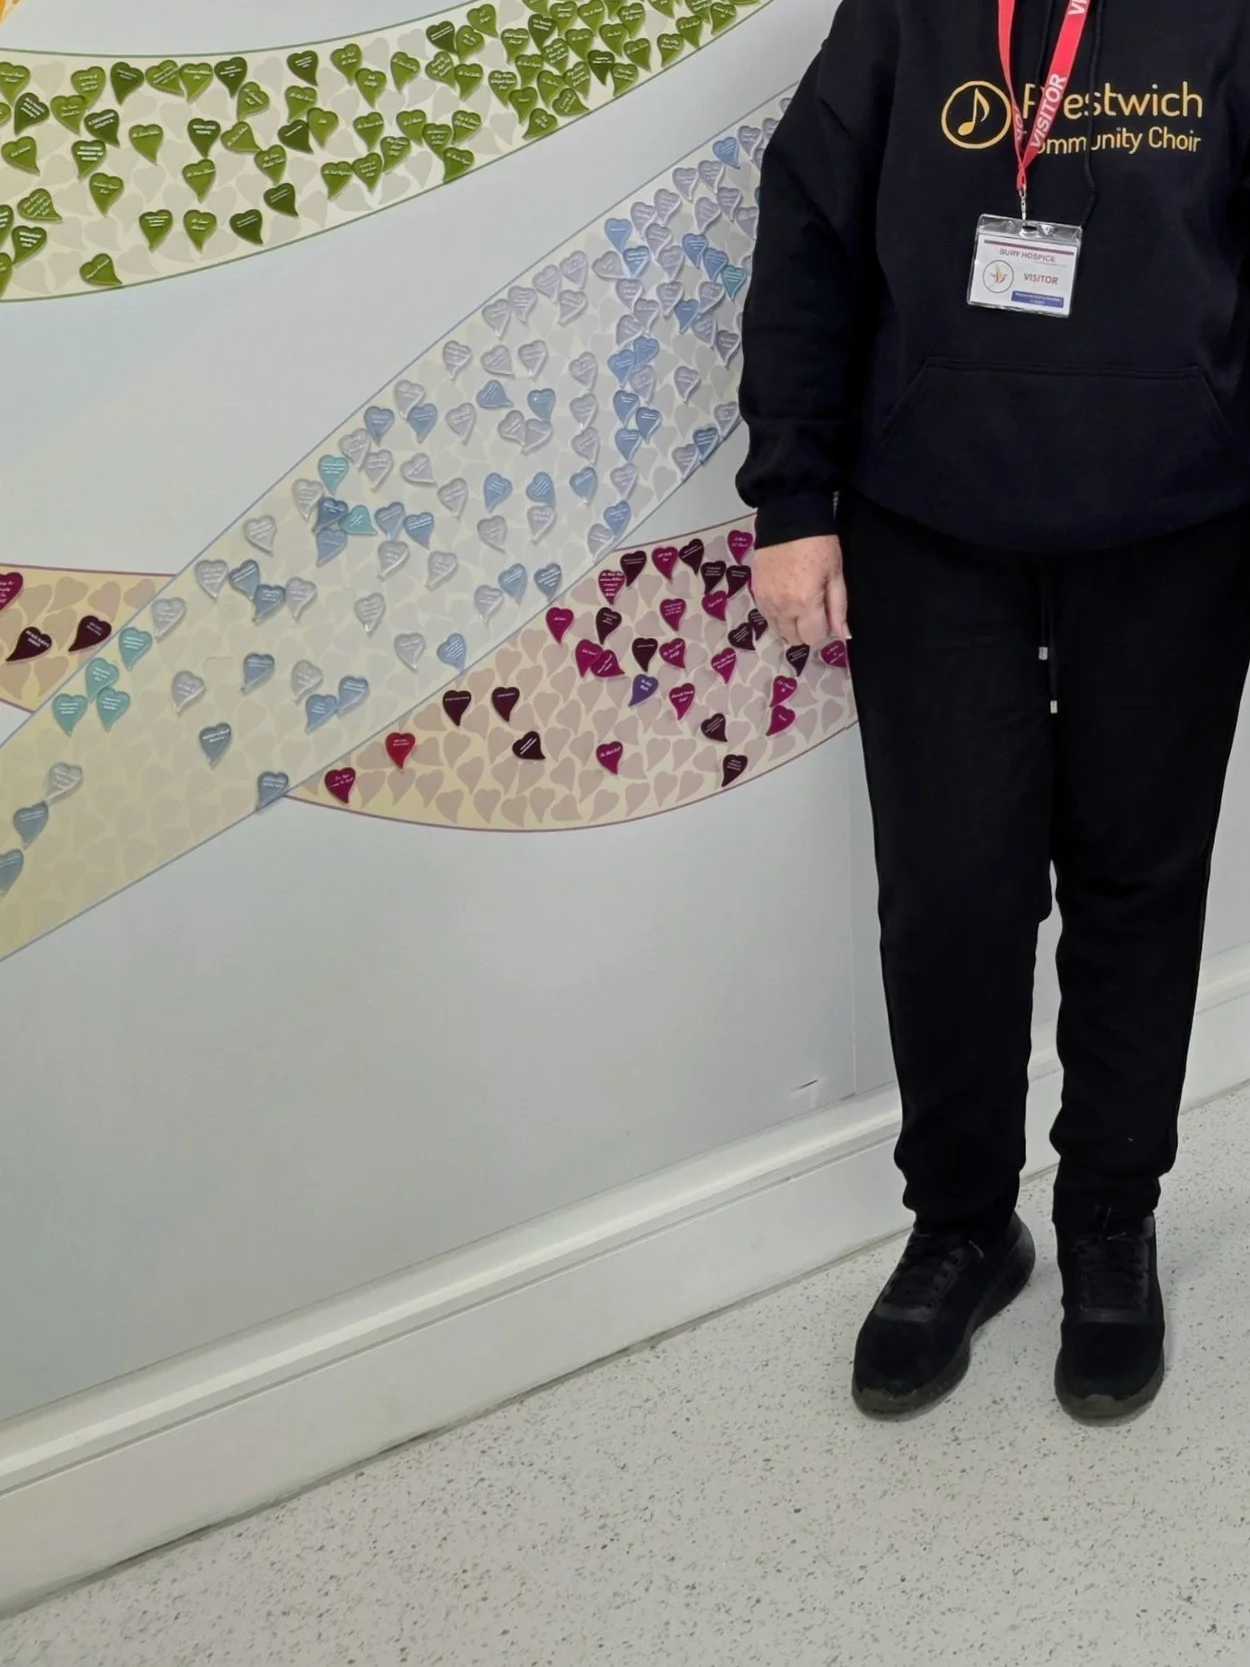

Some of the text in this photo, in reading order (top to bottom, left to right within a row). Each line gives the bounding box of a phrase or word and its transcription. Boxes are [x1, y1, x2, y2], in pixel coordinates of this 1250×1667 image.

[1023, 81, 1203, 120] Pestwich
[1030, 73, 1067, 148] VISITOR
[1036, 126, 1202, 154] mmunity Choir
[1000, 248, 1056, 263] BURY HOSPICE
[1023, 272, 1059, 286] VISITOR
